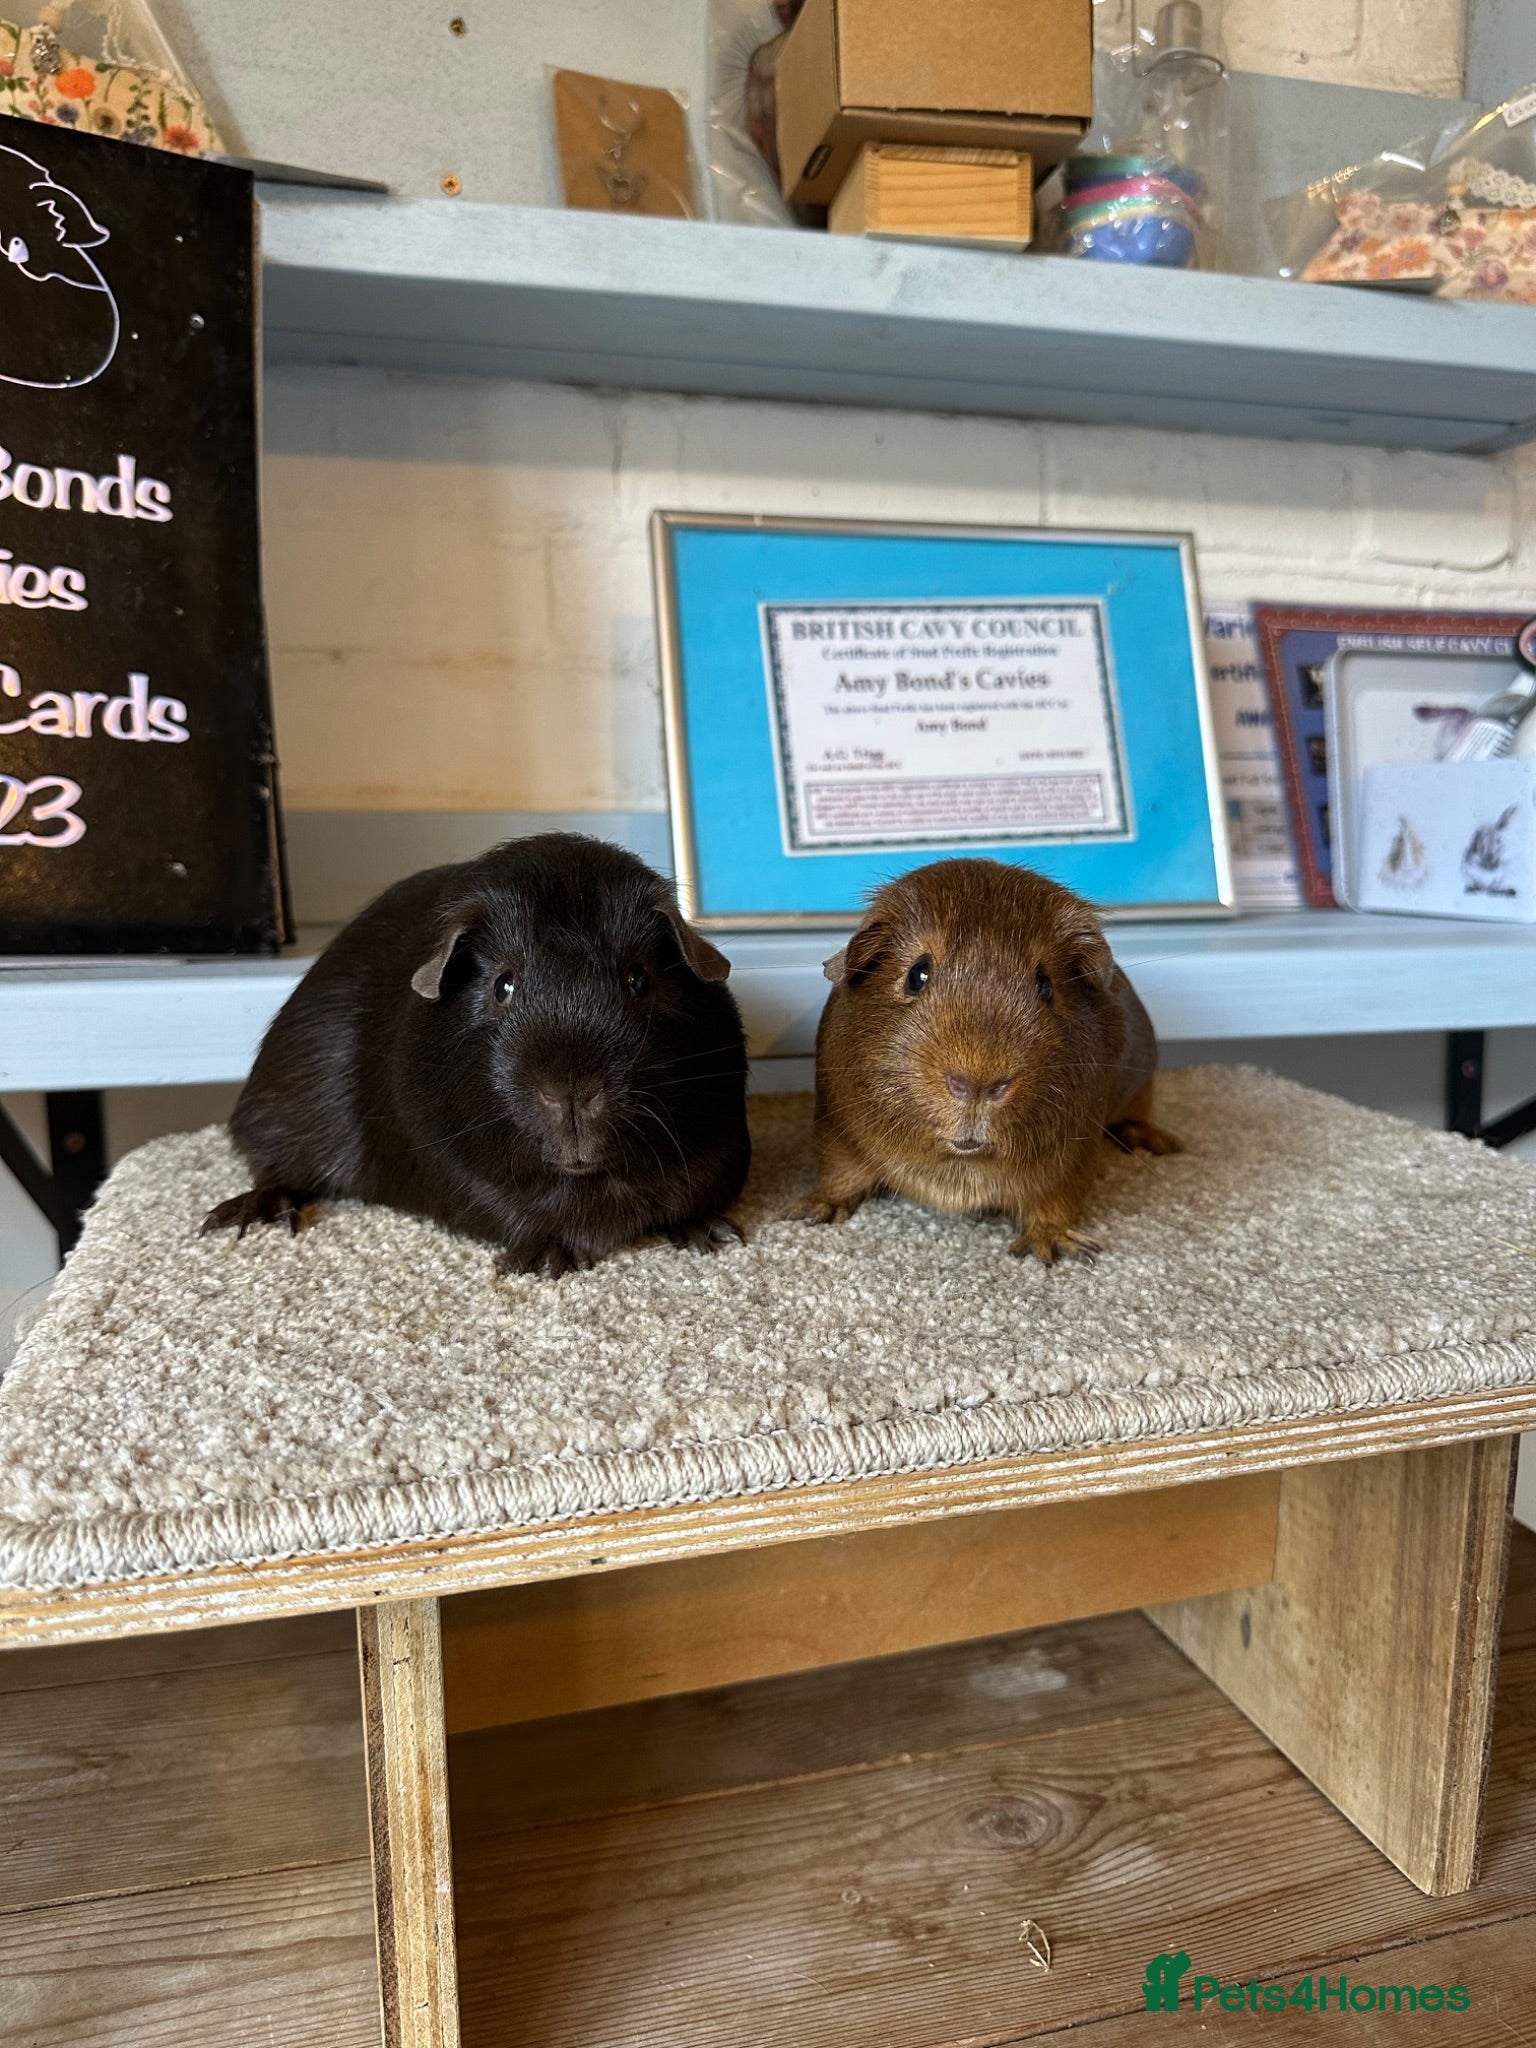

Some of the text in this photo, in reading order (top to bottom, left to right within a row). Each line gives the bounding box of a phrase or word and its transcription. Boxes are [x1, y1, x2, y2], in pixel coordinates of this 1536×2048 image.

[792, 616, 1085, 641] BRITISH CAVY COUNCIL
[1448, 637, 1490, 653] CAVY
[835, 665, 1051, 698] Amy Bond's Cavies
[0, 663, 190, 743] Cards
[915, 716, 988, 736] Amy Bond
